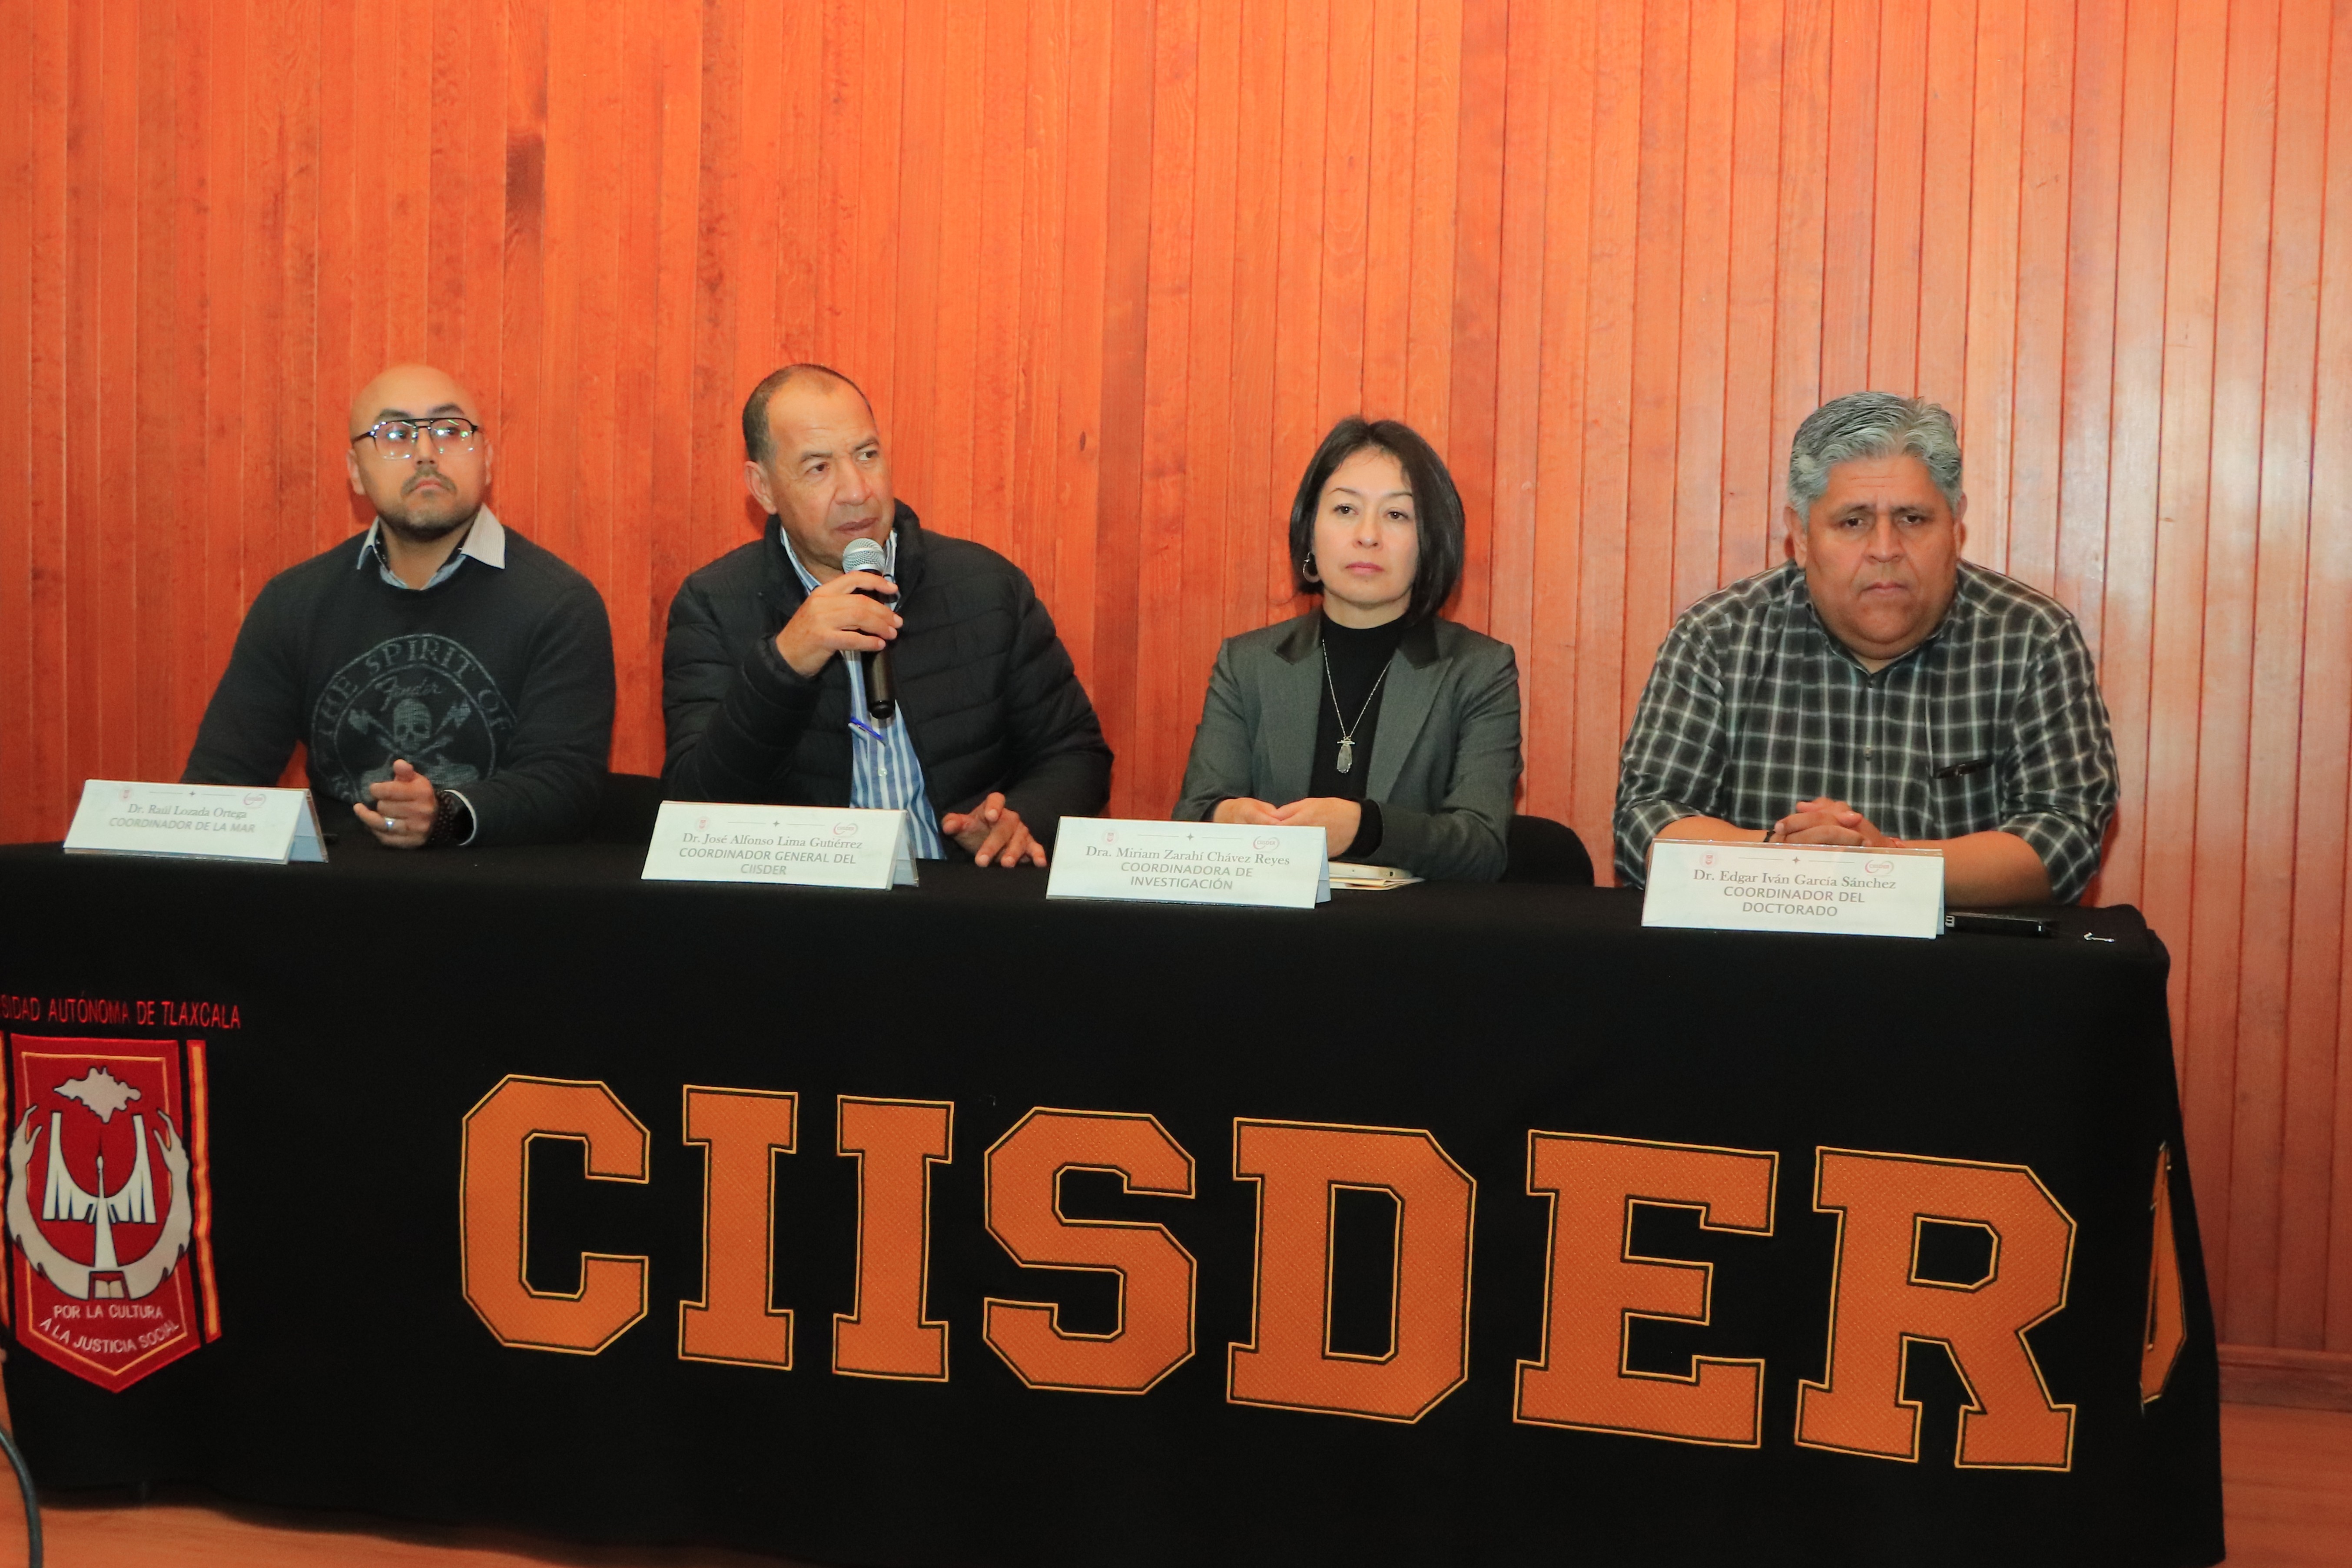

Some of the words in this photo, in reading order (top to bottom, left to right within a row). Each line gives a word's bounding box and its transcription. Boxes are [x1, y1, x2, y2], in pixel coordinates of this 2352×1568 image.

[365, 637, 476, 680] SPIRIT
[127, 803, 145, 813] Dr.
[148, 804, 171, 815] Raúl
[174, 806, 210, 816] Lozada
[213, 807, 247, 819] Ortega
[109, 817, 192, 830] COORDINADOR
[196, 822, 210, 831] DE
[213, 822, 226, 832] LA
[230, 823, 255, 833] MAR
[683, 833, 700, 843] Dr.
[701, 833, 728, 844] José
[730, 835, 774, 846] Alfonso
[776, 836, 806, 847] Lima
[810, 837, 863, 849] Gutiérrez
[679, 848, 771, 861] COORDINADOR
[775, 851, 829, 863] GENERAL
[833, 854, 857, 865] DEL
[1085, 845, 1112, 857] Dra.
[1115, 847, 1160, 859] Miriam
[1164, 849, 1203, 861] Zarahí
[1207, 851, 1251, 863] Chávez
[1254, 853, 1290, 866] Reyes
[740, 864, 787, 875] CIISDER
[1121, 862, 1231, 876] COORDINADORA
[1235, 867, 1254, 877] DE
[1130, 876, 1233, 890] INVESTIGACIÓN
[1692, 869, 1715, 881] Dr.
[1719, 870, 1758, 884] Edgar
[1761, 872, 1790, 885] Iván
[1794, 874, 1838, 887] García
[1841, 876, 1897, 889] Sánchez
[1723, 886, 1834, 902] COORDINADOR
[1838, 892, 1865, 903] DEL
[1742, 902, 1838, 917] DOCTORADO
[47, 990, 130, 1024] AUTÓNOMA
[136, 1000, 156, 1025] DE
[161, 1000, 241, 1029] TLAXCALA
[460, 1073, 2077, 1473] CIISDER
[53, 1305, 81, 1319] POR
[86, 1305, 104, 1319] LA
[109, 1304, 164, 1319] CULTURA
[40, 1317, 53, 1332] A
[51, 1324, 71, 1345] LA
[73, 1335, 138, 1353] JUSTICIA
[138, 1319, 179, 1349] SOCIAL
